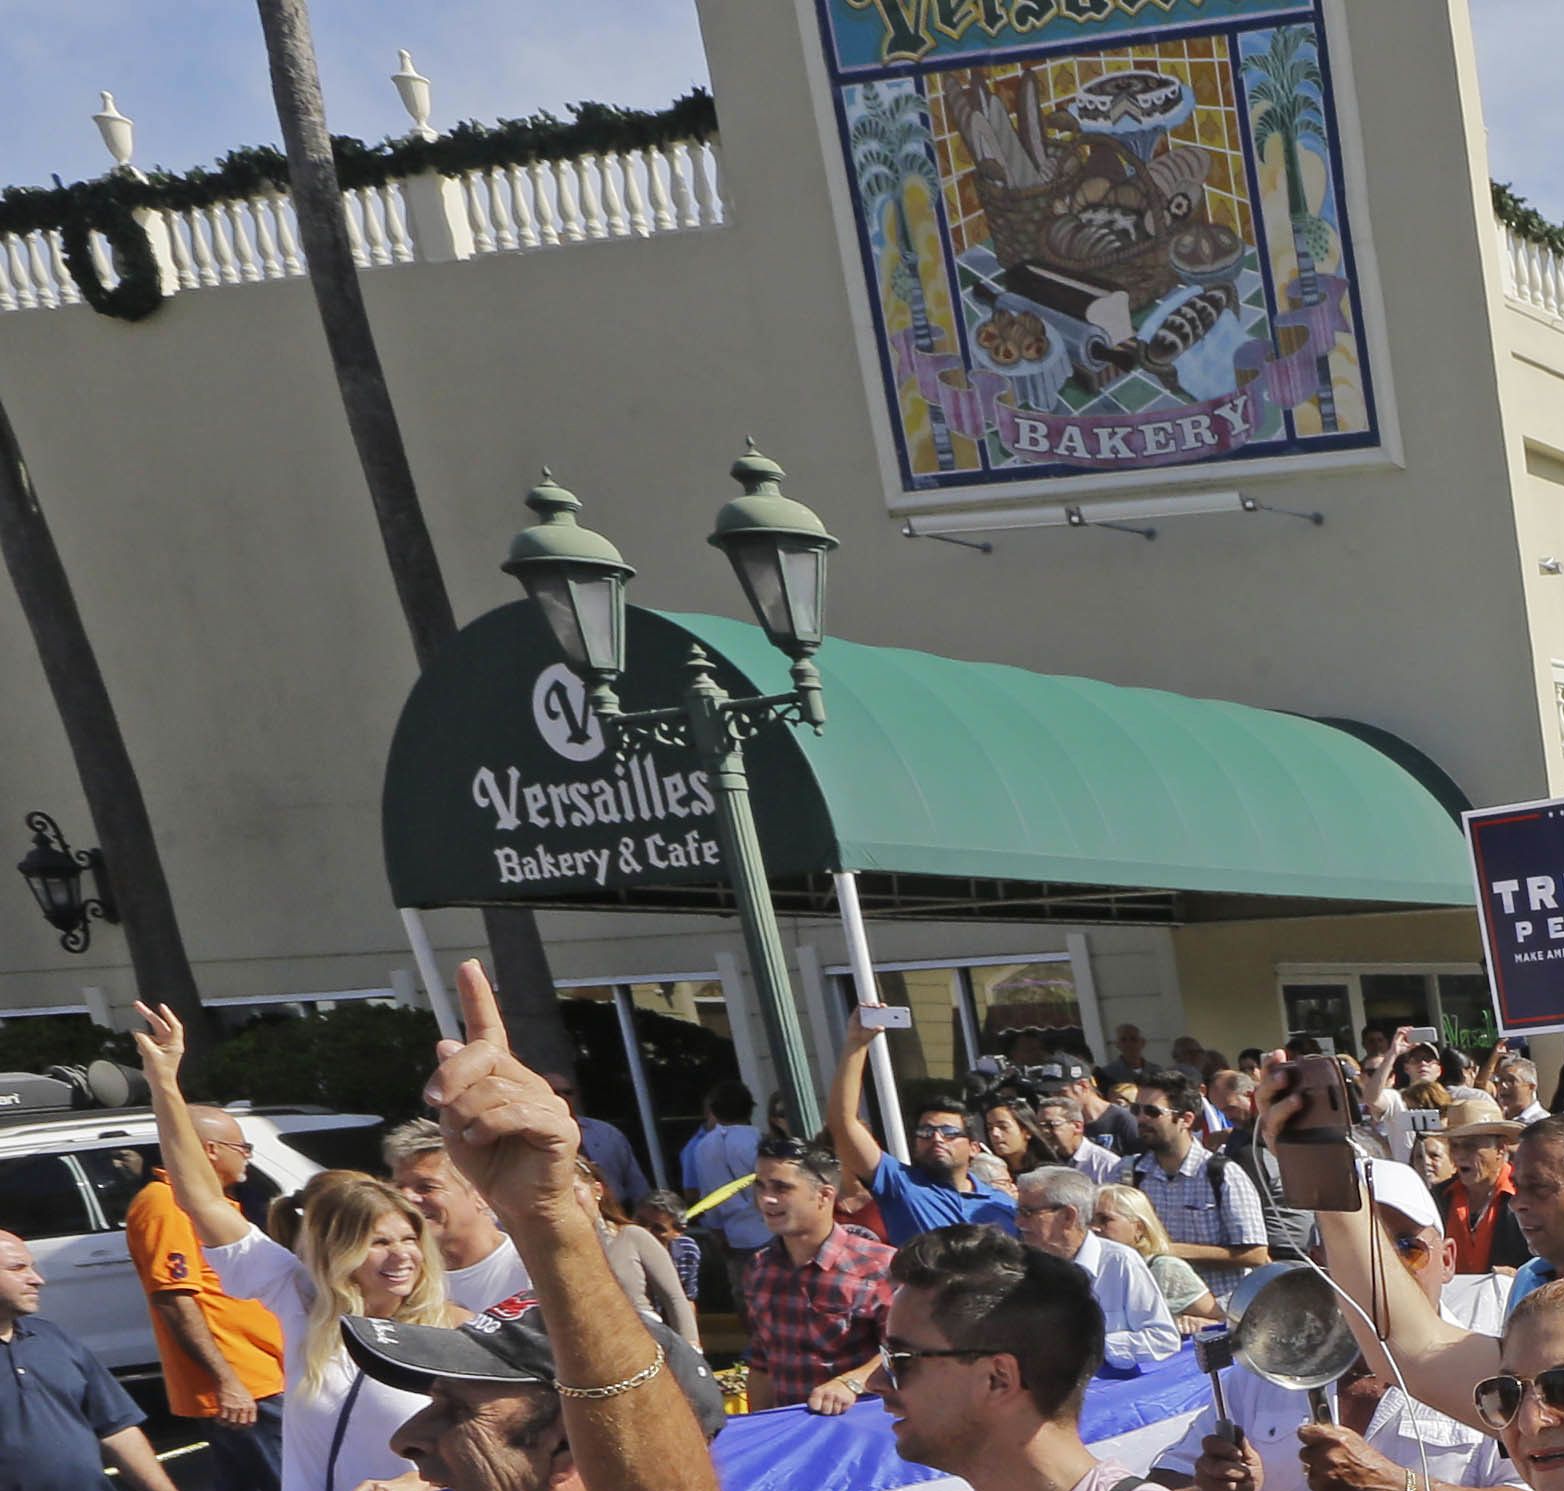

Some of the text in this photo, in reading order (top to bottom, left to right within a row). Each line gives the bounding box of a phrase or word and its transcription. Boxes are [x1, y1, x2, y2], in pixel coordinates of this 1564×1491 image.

[1013, 395, 1249, 459] BAKERY
[472, 752, 716, 831] Versailles
[494, 830, 720, 886] Bakery & Cafe
[1514, 950, 1544, 963] MAKE
[165, 1252, 188, 1279] 3
